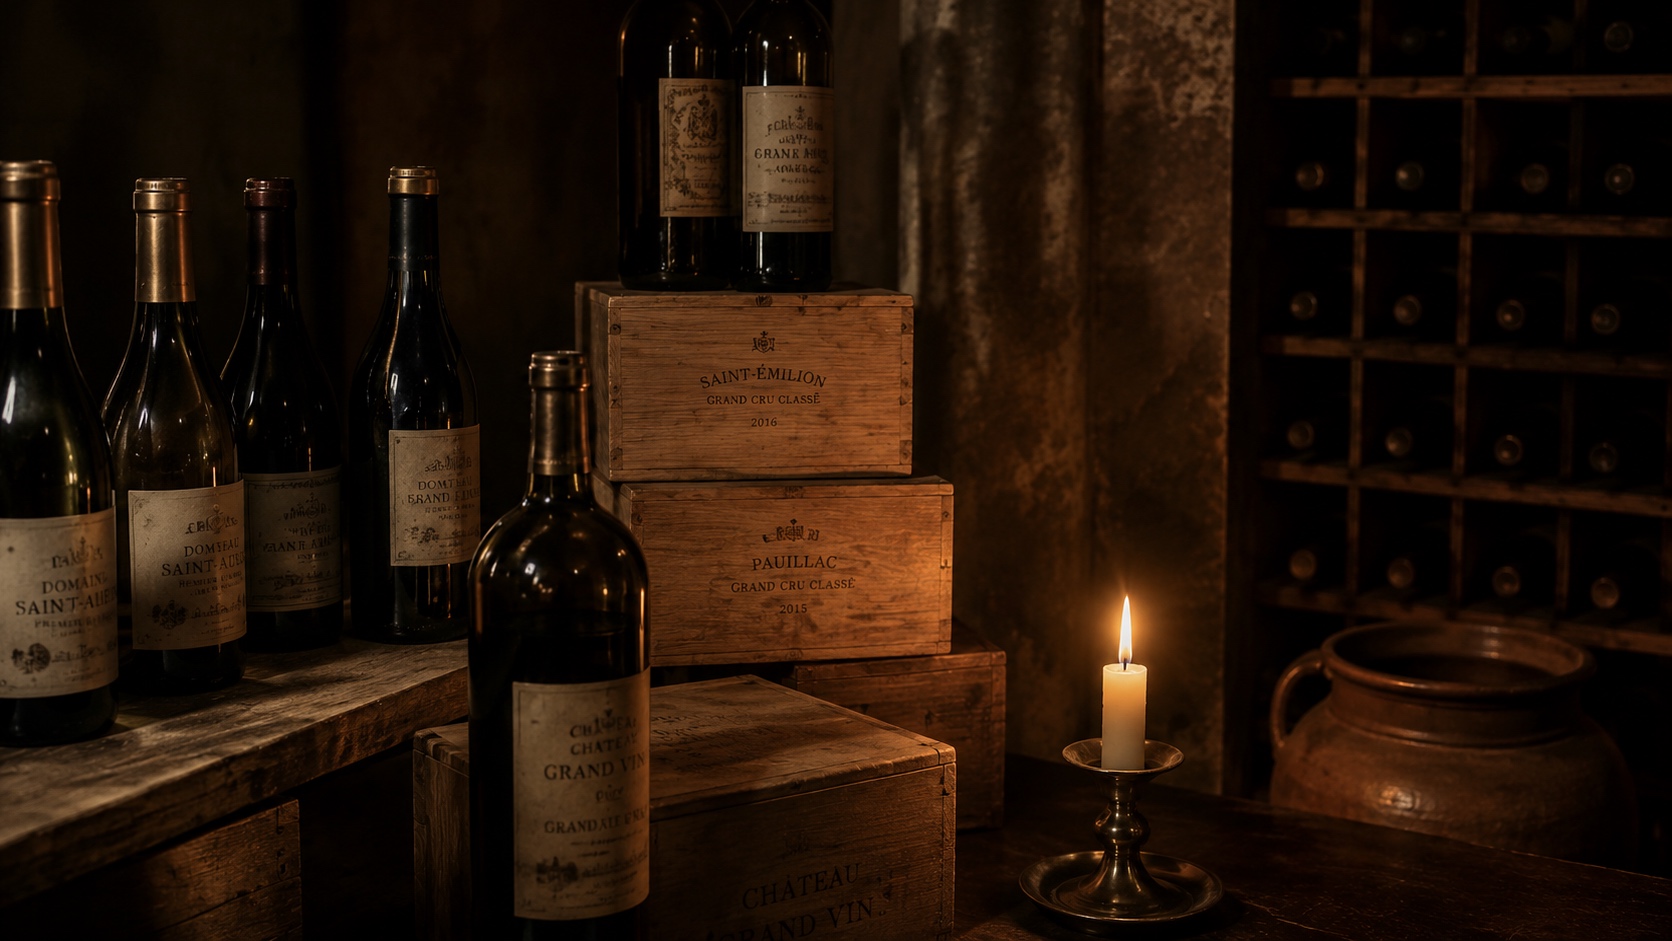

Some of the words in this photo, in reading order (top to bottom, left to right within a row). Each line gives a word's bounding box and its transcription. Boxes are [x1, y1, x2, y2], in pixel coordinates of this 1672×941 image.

[700, 364, 826, 389] SAINT-ÉMILION
[706, 395, 748, 405] GRAND
[751, 395, 775, 405] CRU
[751, 417, 778, 427] 2016
[752, 555, 837, 571] PAUILLAC
[731, 581, 776, 593] GRAND
[780, 580, 805, 591] CRU
[779, 604, 807, 614] 2015
[544, 761, 615, 781] GRAND
[827, 897, 875, 928] VIN
